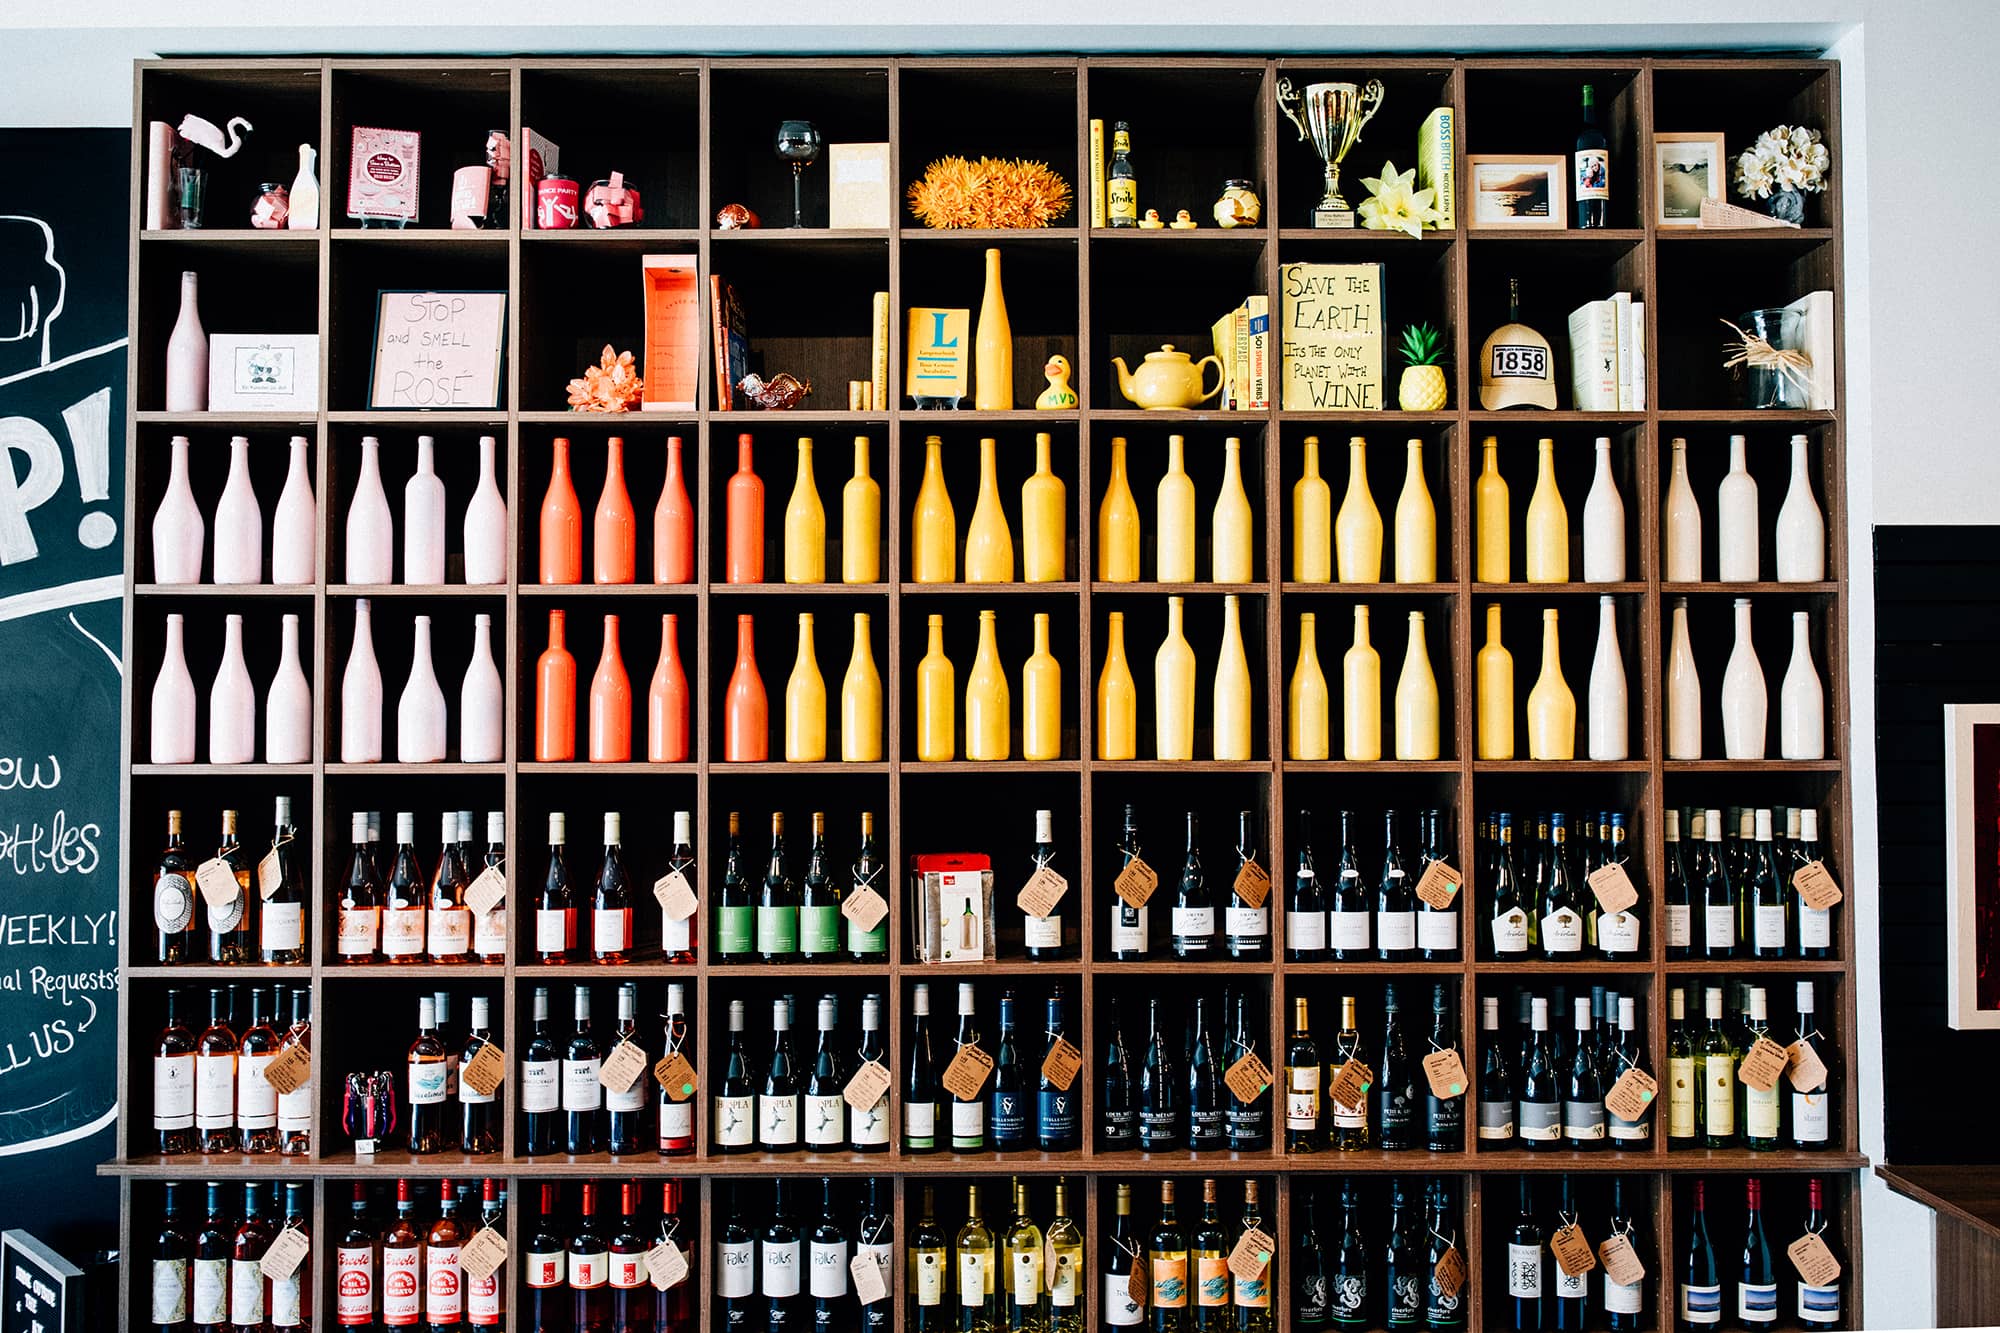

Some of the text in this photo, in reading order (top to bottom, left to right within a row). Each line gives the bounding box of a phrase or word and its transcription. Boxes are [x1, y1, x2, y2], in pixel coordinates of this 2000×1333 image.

[1440, 115, 1450, 140] BOSS
[1441, 142, 1452, 170] BITCH
[557, 188, 577, 196] PARTY
[1286, 267, 1370, 298] SAVE THE
[403, 294, 466, 323] STOP
[1294, 299, 1373, 334] EARTH.
[421, 331, 471, 348] SMELL
[931, 312, 958, 347] L
[414, 352, 443, 370] the
[1309, 344, 1327, 358] THE
[1334, 346, 1363, 360] ONLY
[1495, 351, 1544, 372] 1858
[1294, 363, 1367, 379] PLANET WITH
[392, 370, 473, 405] ROSÉ
[1048, 392, 1076, 405] MVD
[1308, 381, 1379, 410] WINE.
[29, 1019, 75, 1058] US
